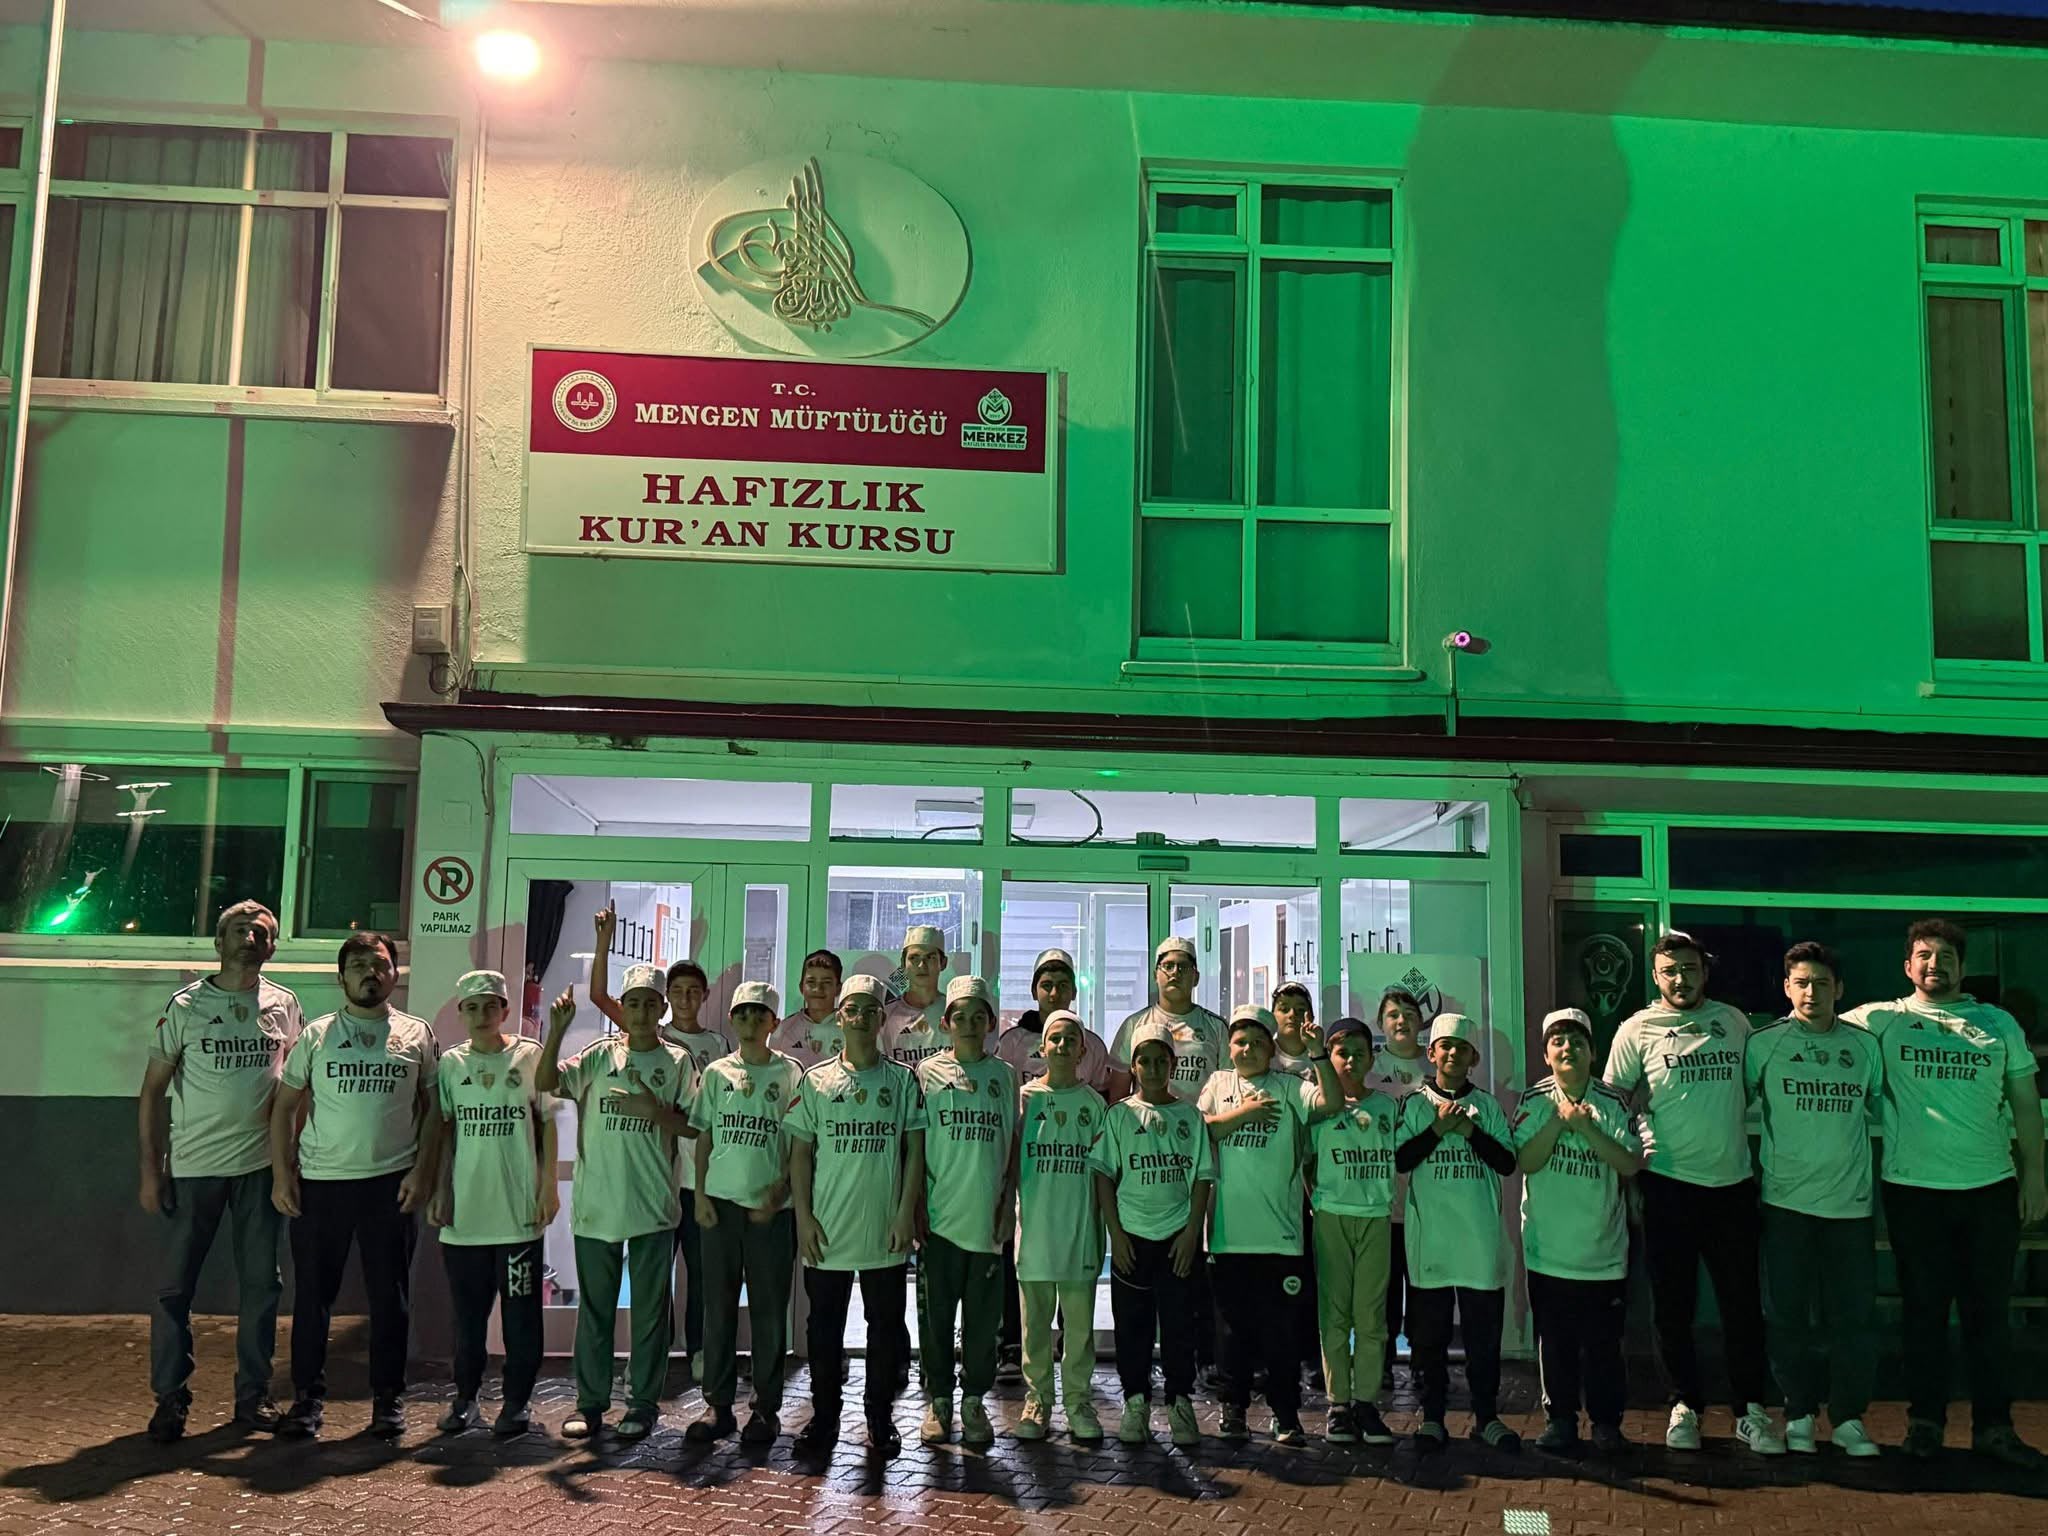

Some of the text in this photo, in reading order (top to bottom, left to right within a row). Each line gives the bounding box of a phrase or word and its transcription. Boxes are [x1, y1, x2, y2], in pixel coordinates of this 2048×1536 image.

[771, 383, 817, 396] T.C.
[634, 403, 948, 436] MENGEN MÜFTÜLÜĞÜ
[963, 431, 1025, 444] MERKEZ
[642, 473, 926, 513] HAFIZLIK
[578, 515, 956, 555] KUR'AN KURSU
[432, 911, 461, 922] PARK
[420, 923, 472, 934] YAPILMAZ
[200, 1036, 282, 1054] Emirates
[214, 1054, 272, 1070] FLY BETTER
[1176, 1055, 1207, 1069] rates
[1663, 1050, 1740, 1069] Emirates
[1901, 1045, 1992, 1067] Emirates
[326, 1060, 409, 1079] Emirates
[1681, 1067, 1733, 1084] FLY BETTER
[1914, 1065, 1977, 1081] FLY BETTER
[338, 1079, 397, 1094] FLY BETTER
[1782, 1078, 1863, 1097] Emirates
[457, 1104, 526, 1120] Emirates
[1796, 1097, 1853, 1112] FLY BETTER
[464, 1122, 515, 1136] FLY BETTER
[620, 1118, 655, 1133] BETTER
[825, 1119, 897, 1136] Emirates
[732, 1130, 768, 1148] BETTER
[965, 1126, 996, 1142] BETTER
[1233, 1134, 1268, 1148] BETTER
[851, 1139, 886, 1153] BETTER
[1331, 1146, 1393, 1164] Emirate
[1036, 1159, 1085, 1174] FLY BETTER
[1434, 1165, 1449, 1180] FLY
[1141, 1171, 1156, 1185] FLY
